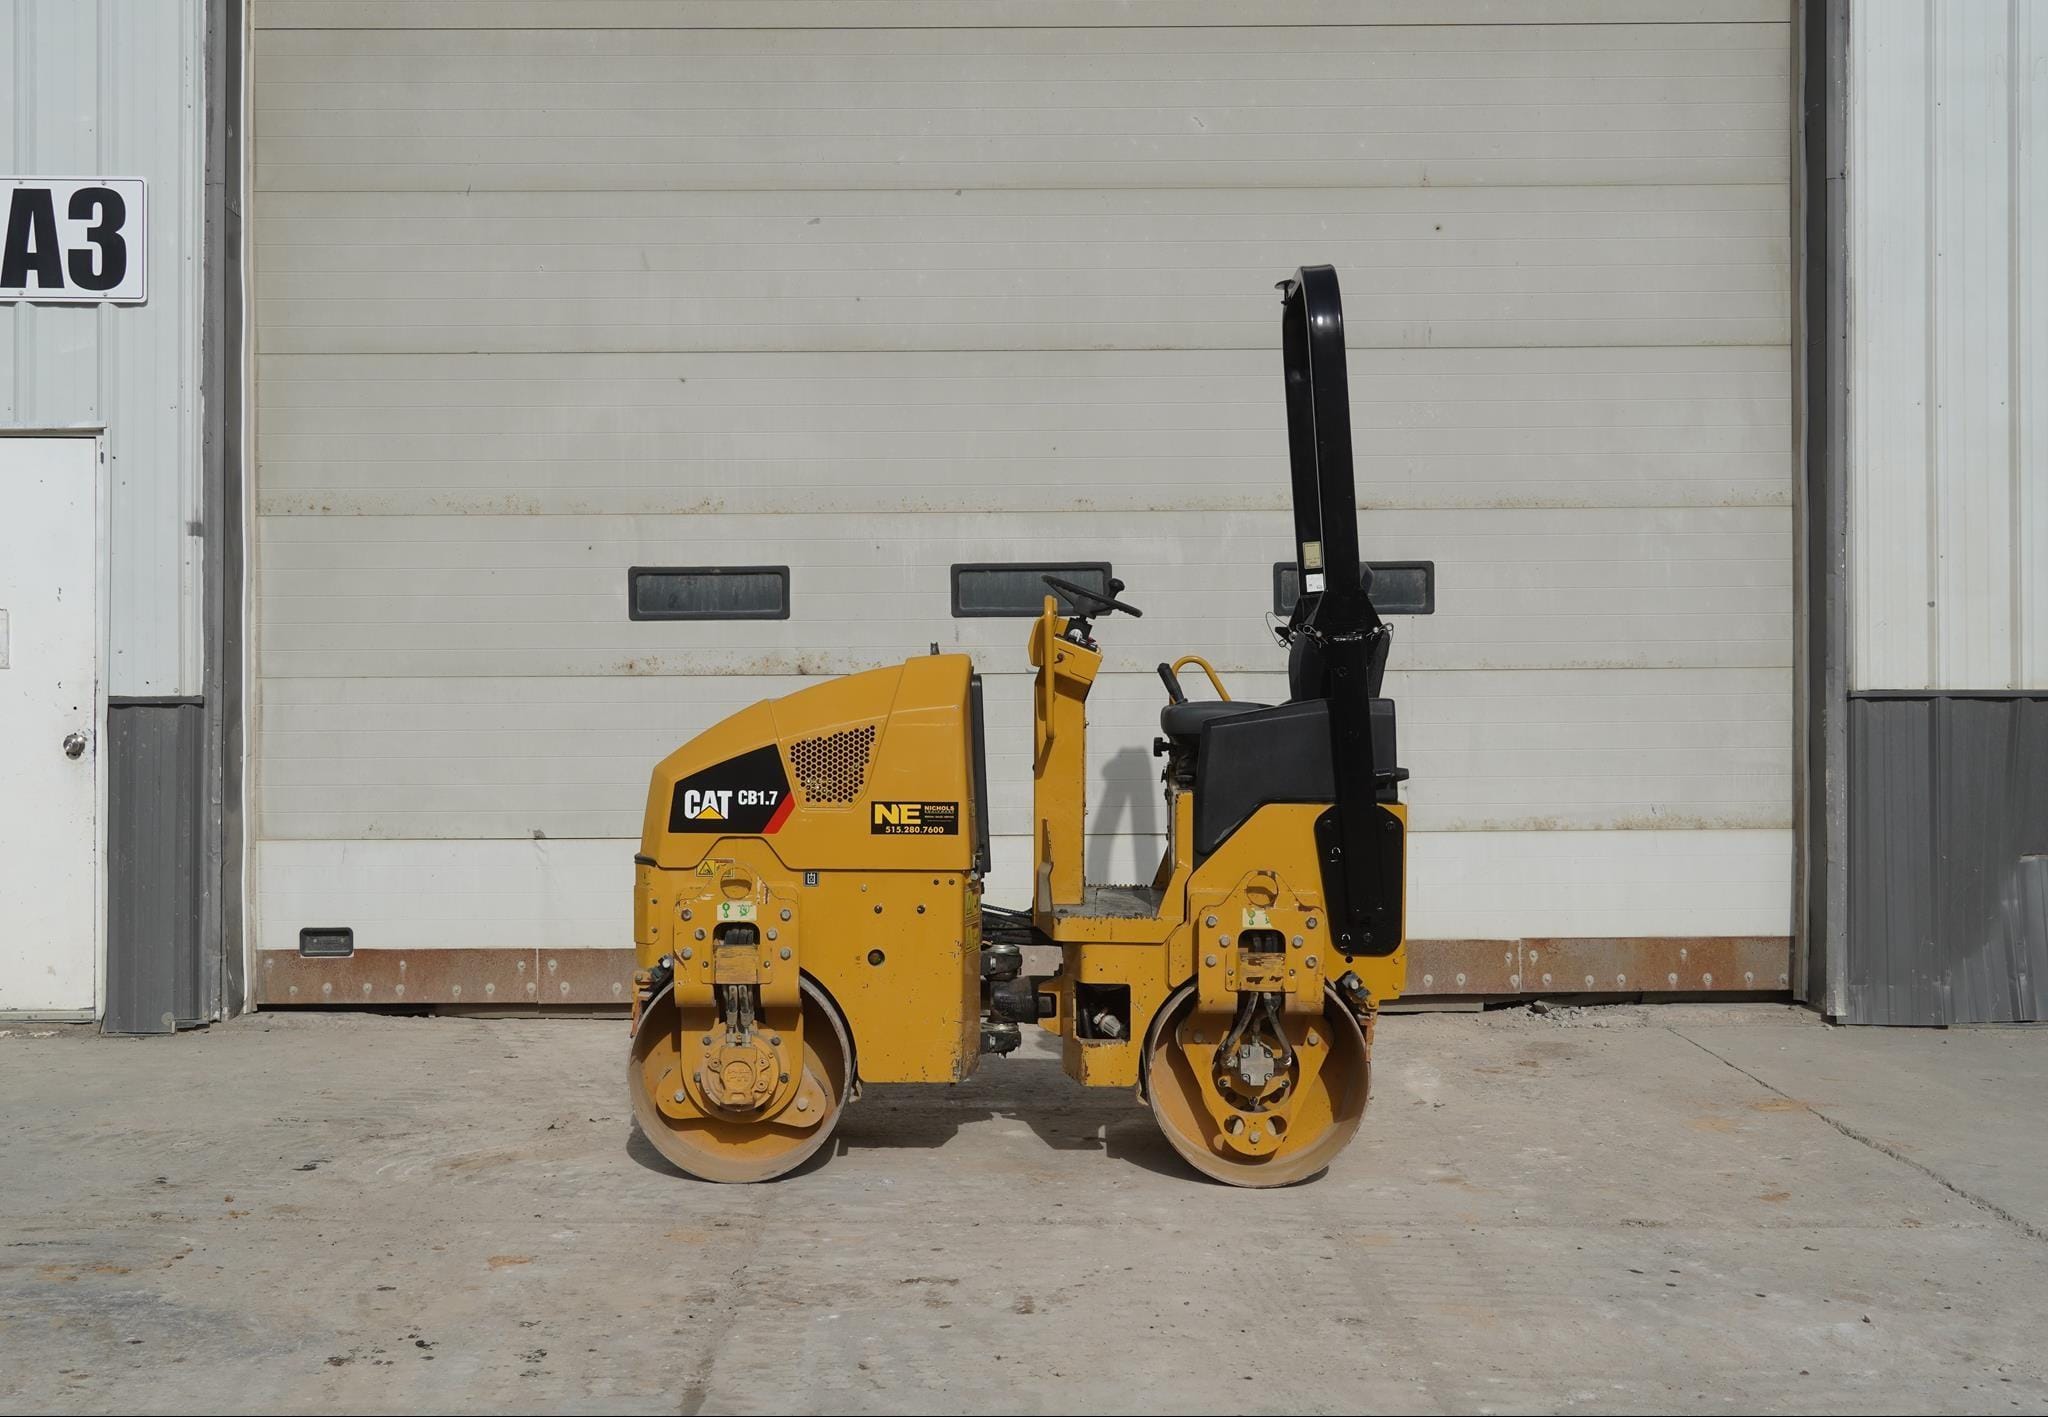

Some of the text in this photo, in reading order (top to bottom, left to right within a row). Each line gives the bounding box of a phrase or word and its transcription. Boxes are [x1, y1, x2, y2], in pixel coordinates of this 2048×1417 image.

[0, 187, 127, 291] A3
[684, 789, 778, 820] CAT CB1.7
[874, 803, 922, 825] NE
[885, 826, 944, 834] 515.280.7600
